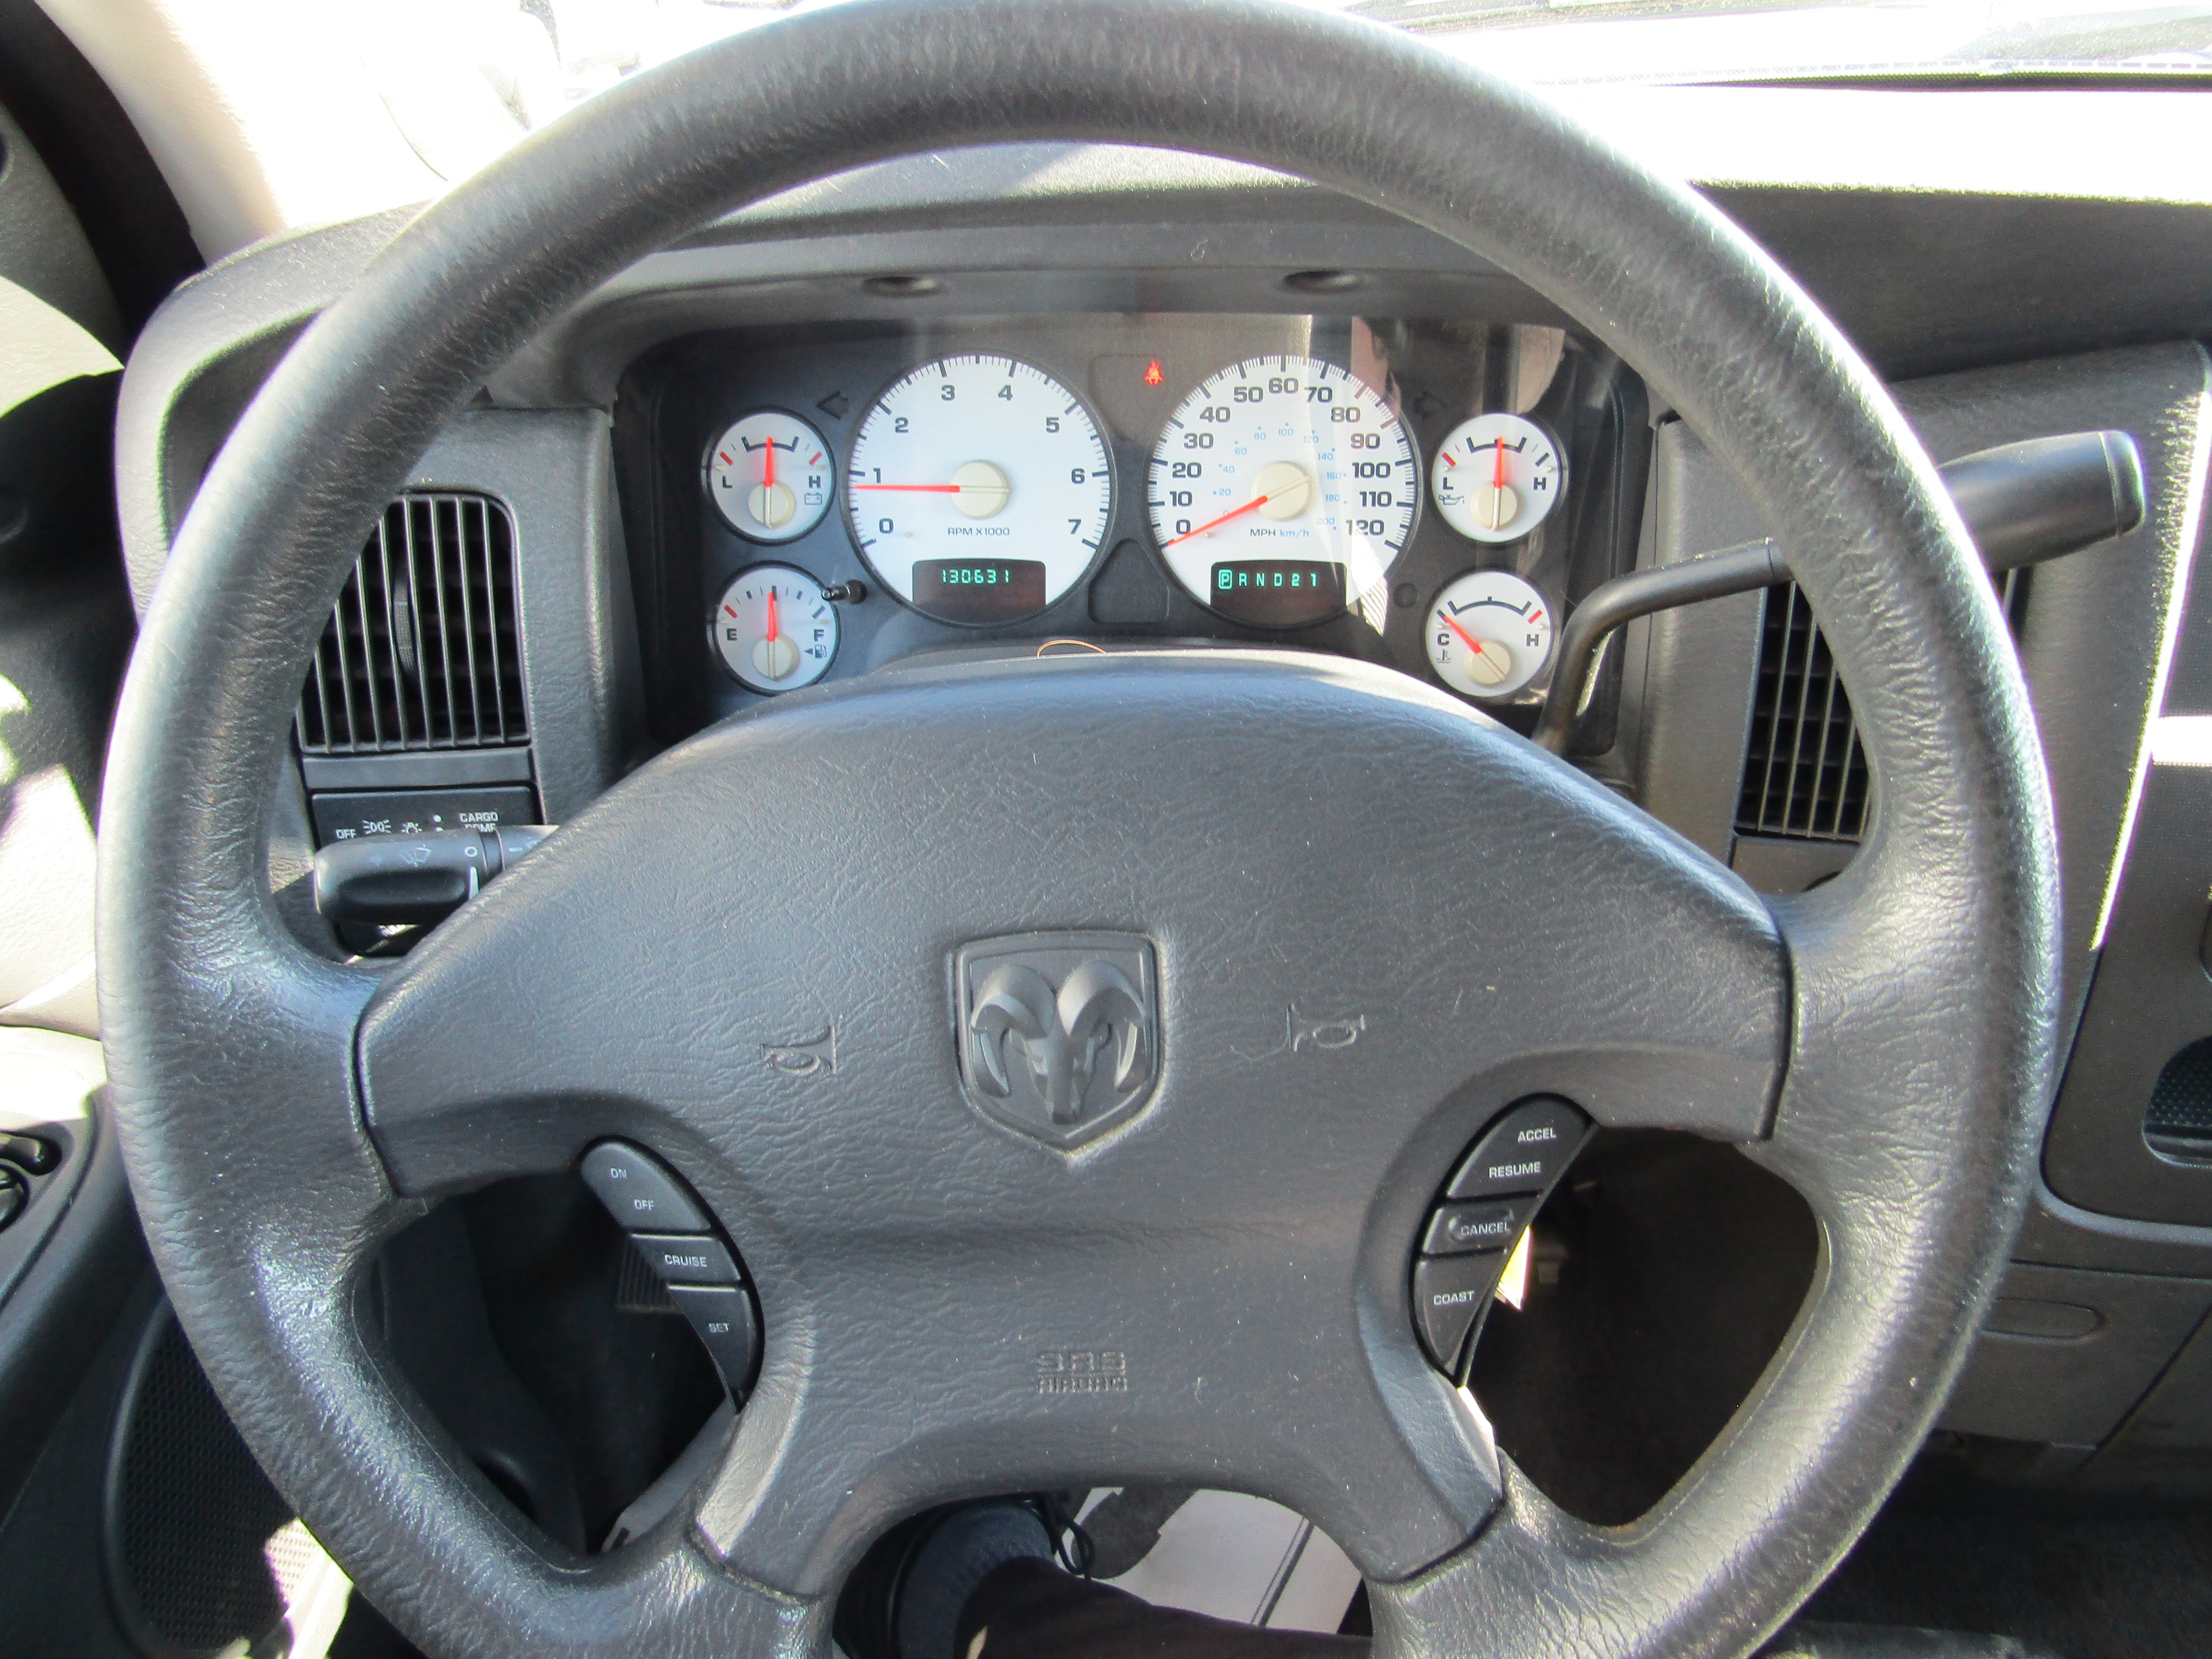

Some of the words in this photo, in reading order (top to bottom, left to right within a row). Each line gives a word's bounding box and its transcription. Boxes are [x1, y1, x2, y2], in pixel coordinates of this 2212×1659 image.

[942, 385, 955, 401] 3
[998, 385, 1013, 401] 4
[1269, 378, 1298, 394] 60
[1234, 387, 1263, 402] 50
[1305, 387, 1332, 402] 70
[1200, 407, 1230, 422] 40
[1331, 407, 1360, 422] 80
[895, 417, 908, 433] 2
[1046, 417, 1059, 433] 5
[1184, 433, 1213, 449] 30
[1351, 434, 1380, 449] 90
[873, 468, 881, 483] 1
[1071, 468, 1085, 484] 6
[1173, 462, 1201, 478] 20
[1352, 462, 1390, 478] 100
[722, 476, 732, 488] L
[809, 476, 820, 488] H
[1443, 477, 1453, 490] L
[1534, 477, 1546, 490] H
[1170, 491, 1192, 506] 10
[1360, 491, 1392, 507] 110
[879, 519, 893, 534] 0
[1068, 519, 1081, 534] 7
[1176, 520, 1191, 535] 0
[1346, 520, 1384, 535] 120
[943, 569, 1009, 583] 130631
[1221, 573, 1229, 586] P
[1239, 573, 1247, 586] R
[1257, 573, 1264, 586] N
[1274, 573, 1282, 586] D
[1292, 573, 1300, 586] 2
[1311, 574, 1316, 586] 1
[727, 629, 737, 641] E
[814, 629, 824, 641] F
[1437, 633, 1449, 646] C
[1526, 634, 1539, 646] H
[459, 812, 498, 823] CARGO
[336, 829, 356, 839] OFF
[1518, 1128, 1556, 1142] ACCEL
[611, 1168, 626, 1178] ON
[1489, 1162, 1540, 1178] RESUME
[634, 1200, 653, 1210] OFF
[1461, 1221, 1511, 1236] CANCEL
[665, 1255, 707, 1267] CRUISE
[1434, 1291, 1474, 1305] COAST
[709, 1323, 729, 1332] SET
